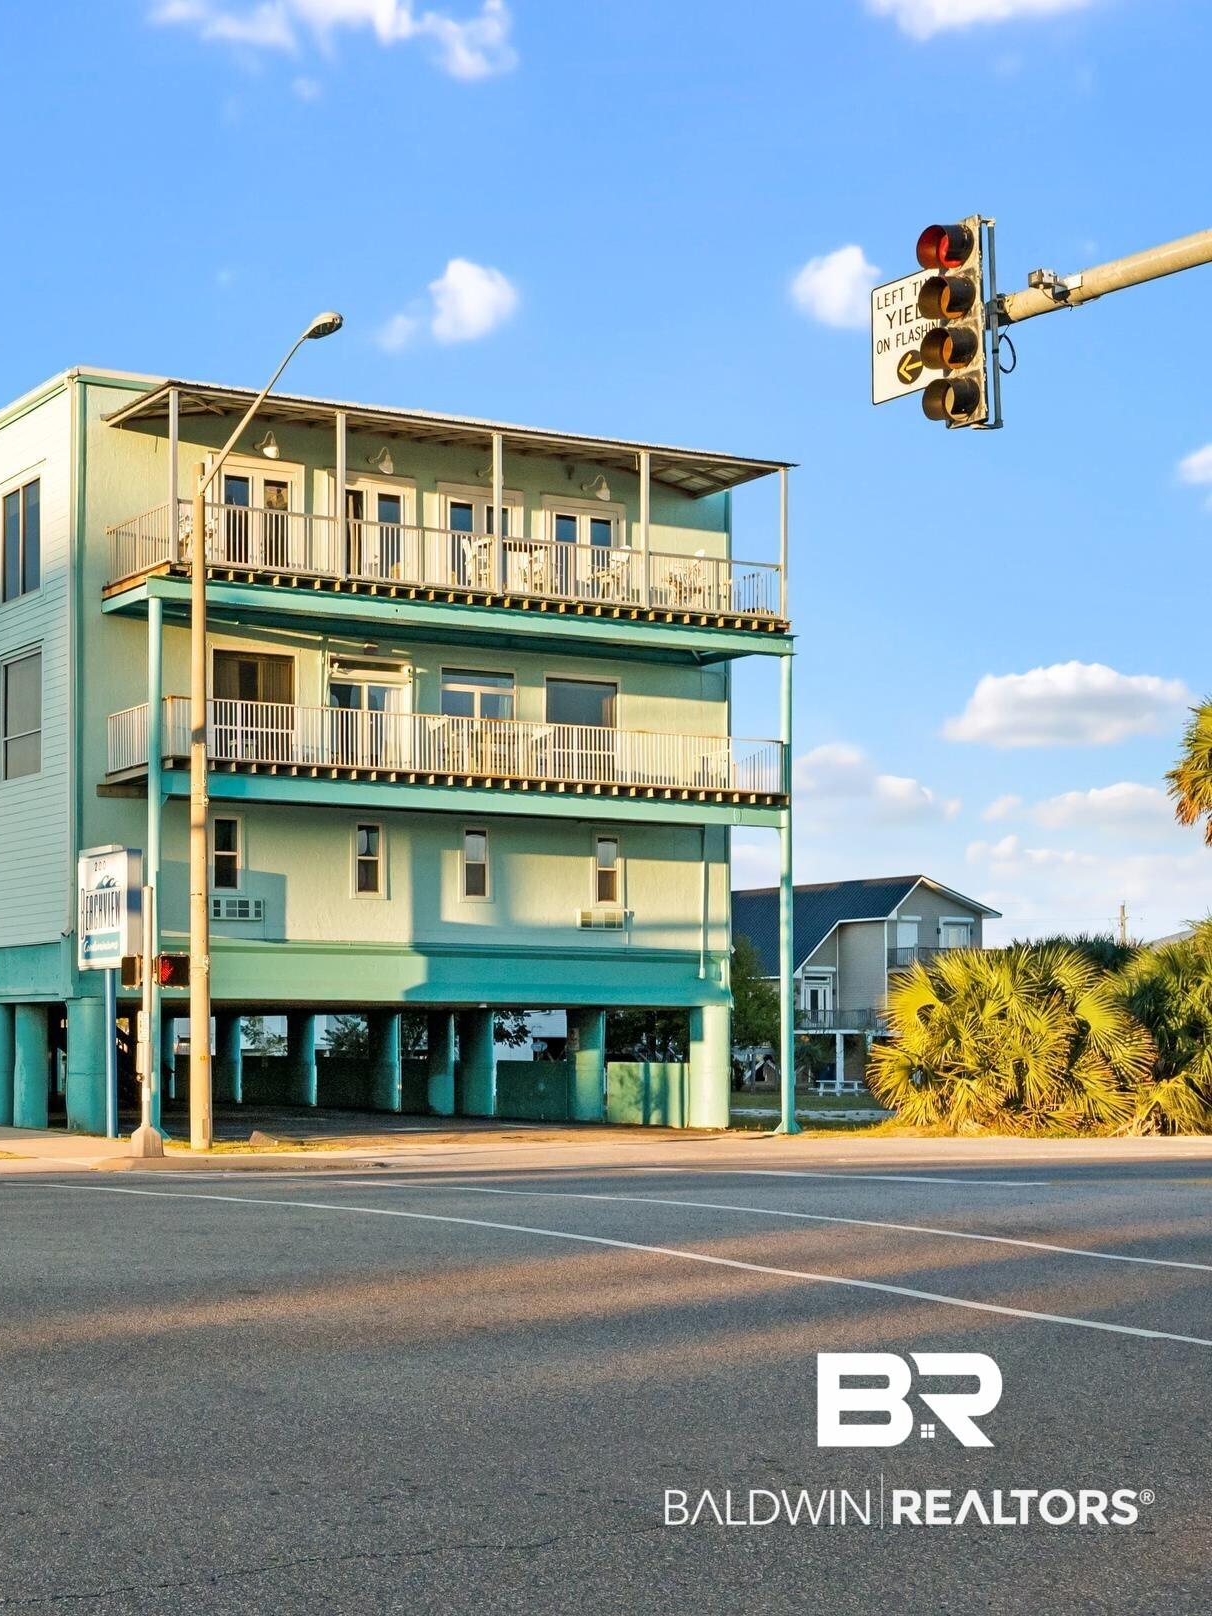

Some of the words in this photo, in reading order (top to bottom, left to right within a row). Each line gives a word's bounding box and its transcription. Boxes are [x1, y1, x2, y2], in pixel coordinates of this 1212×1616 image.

[877, 286, 905, 310] LEFT
[886, 303, 922, 329] YIEL
[876, 337, 890, 355] ON
[80, 887, 121, 941] BEACHVIEW
